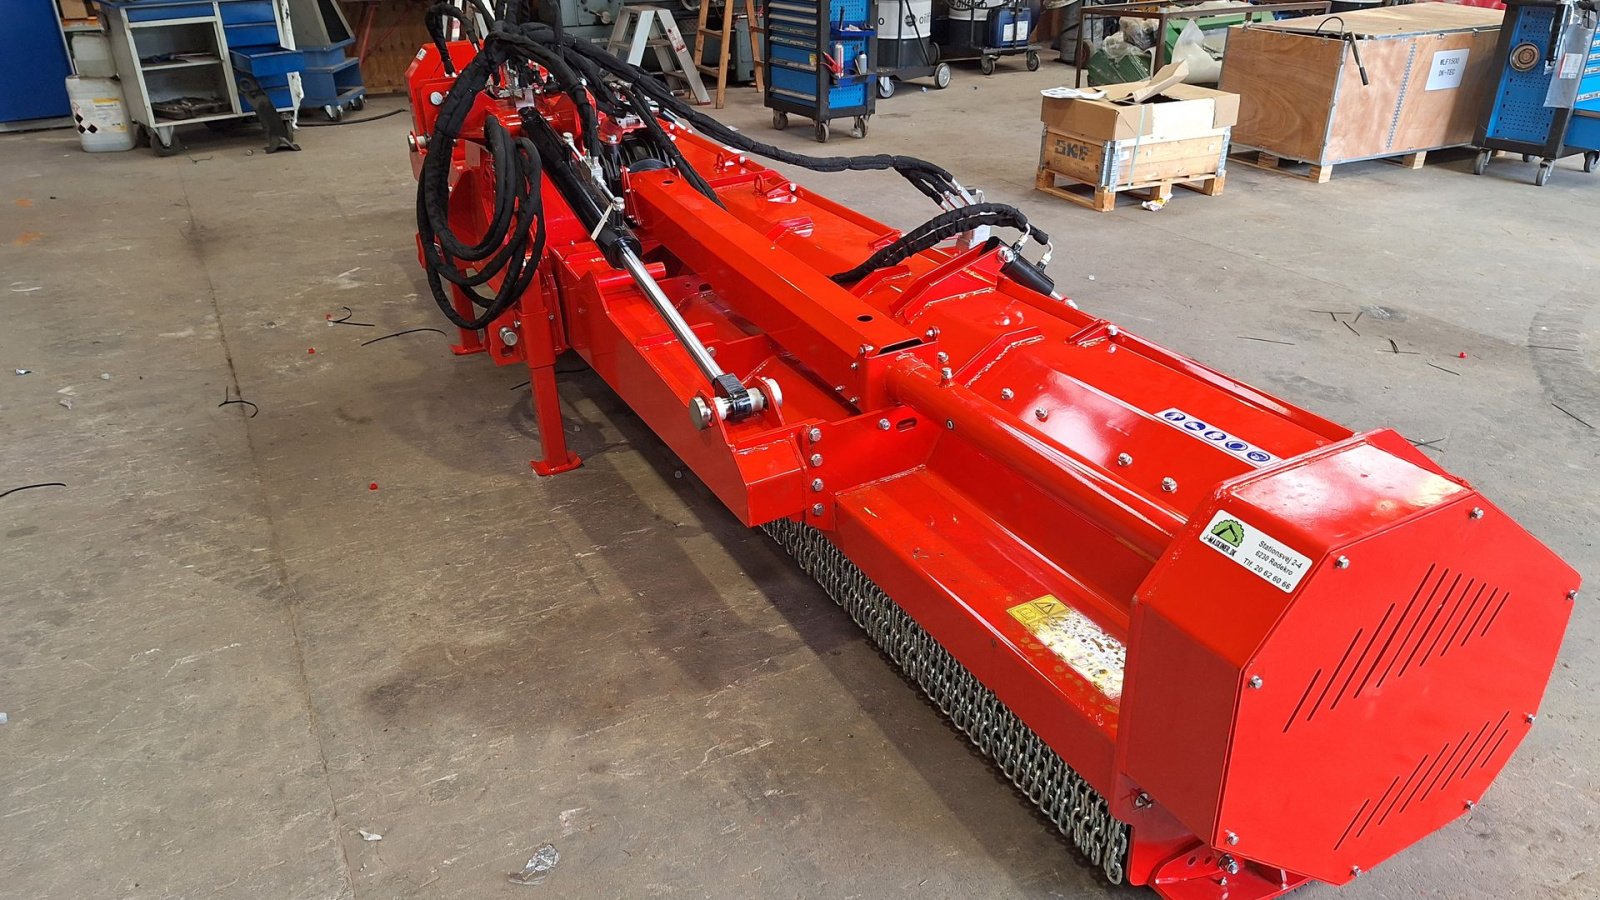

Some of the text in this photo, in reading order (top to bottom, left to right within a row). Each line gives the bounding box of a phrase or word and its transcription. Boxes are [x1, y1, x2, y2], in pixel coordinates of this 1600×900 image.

[1055, 139, 1089, 161] SKF
[1255, 550, 1270, 562] 6230
[1258, 541, 1303, 568] Stationsvej 2-4
[1243, 558, 1291, 589] Tlf. 20 62 60 66
